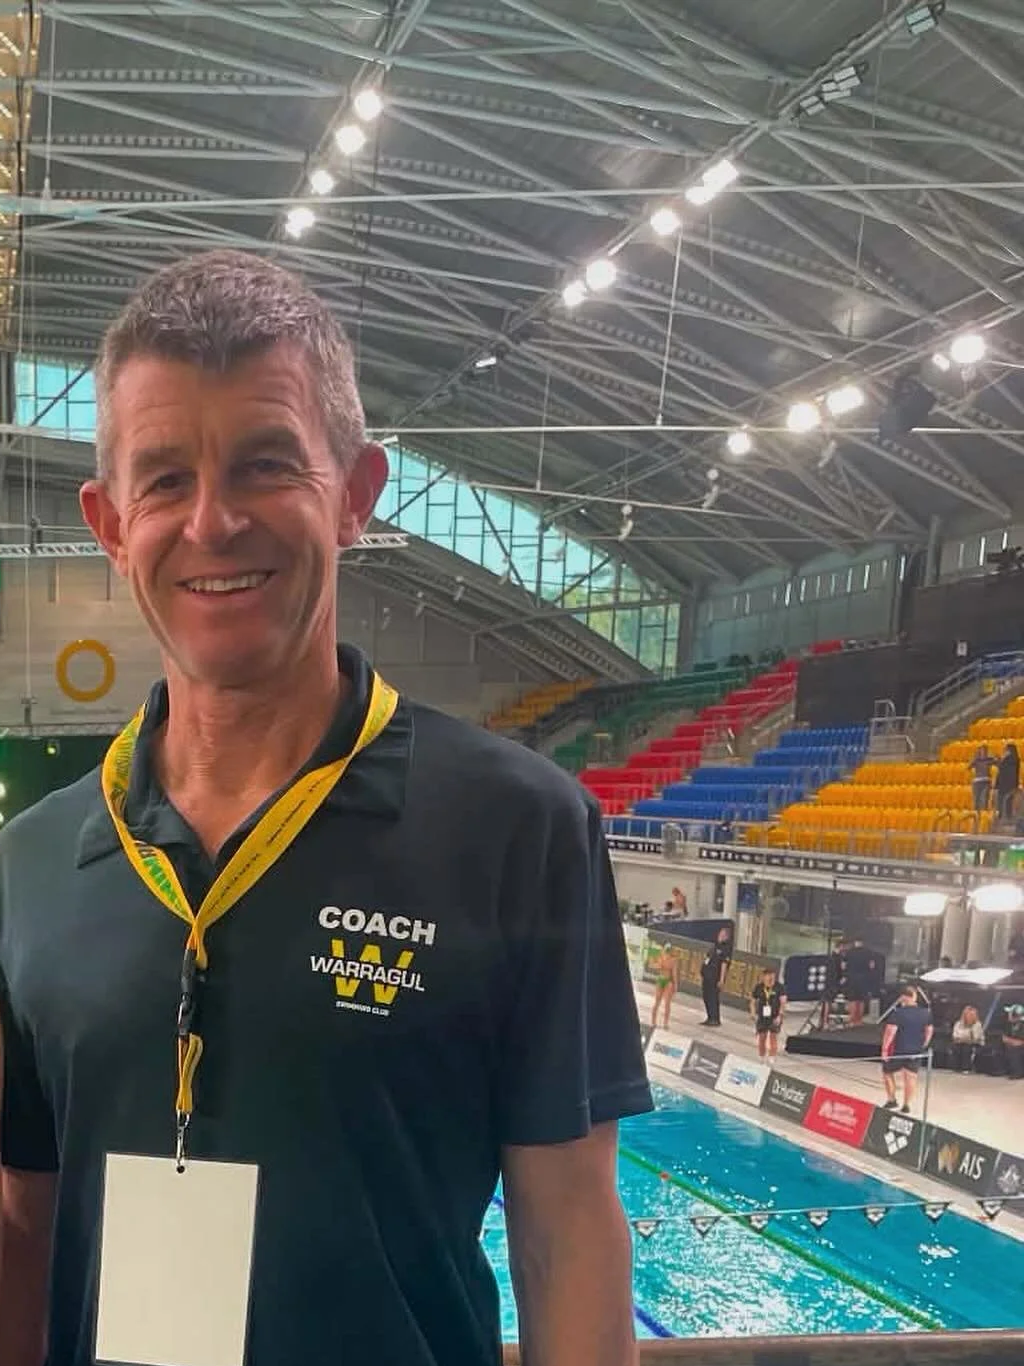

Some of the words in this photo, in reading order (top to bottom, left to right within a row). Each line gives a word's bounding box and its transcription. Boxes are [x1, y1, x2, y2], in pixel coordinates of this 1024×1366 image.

[318, 906, 436, 946] COACH
[309, 955, 425, 992] WARRAGUL
[959, 1151, 985, 1180] AIS
